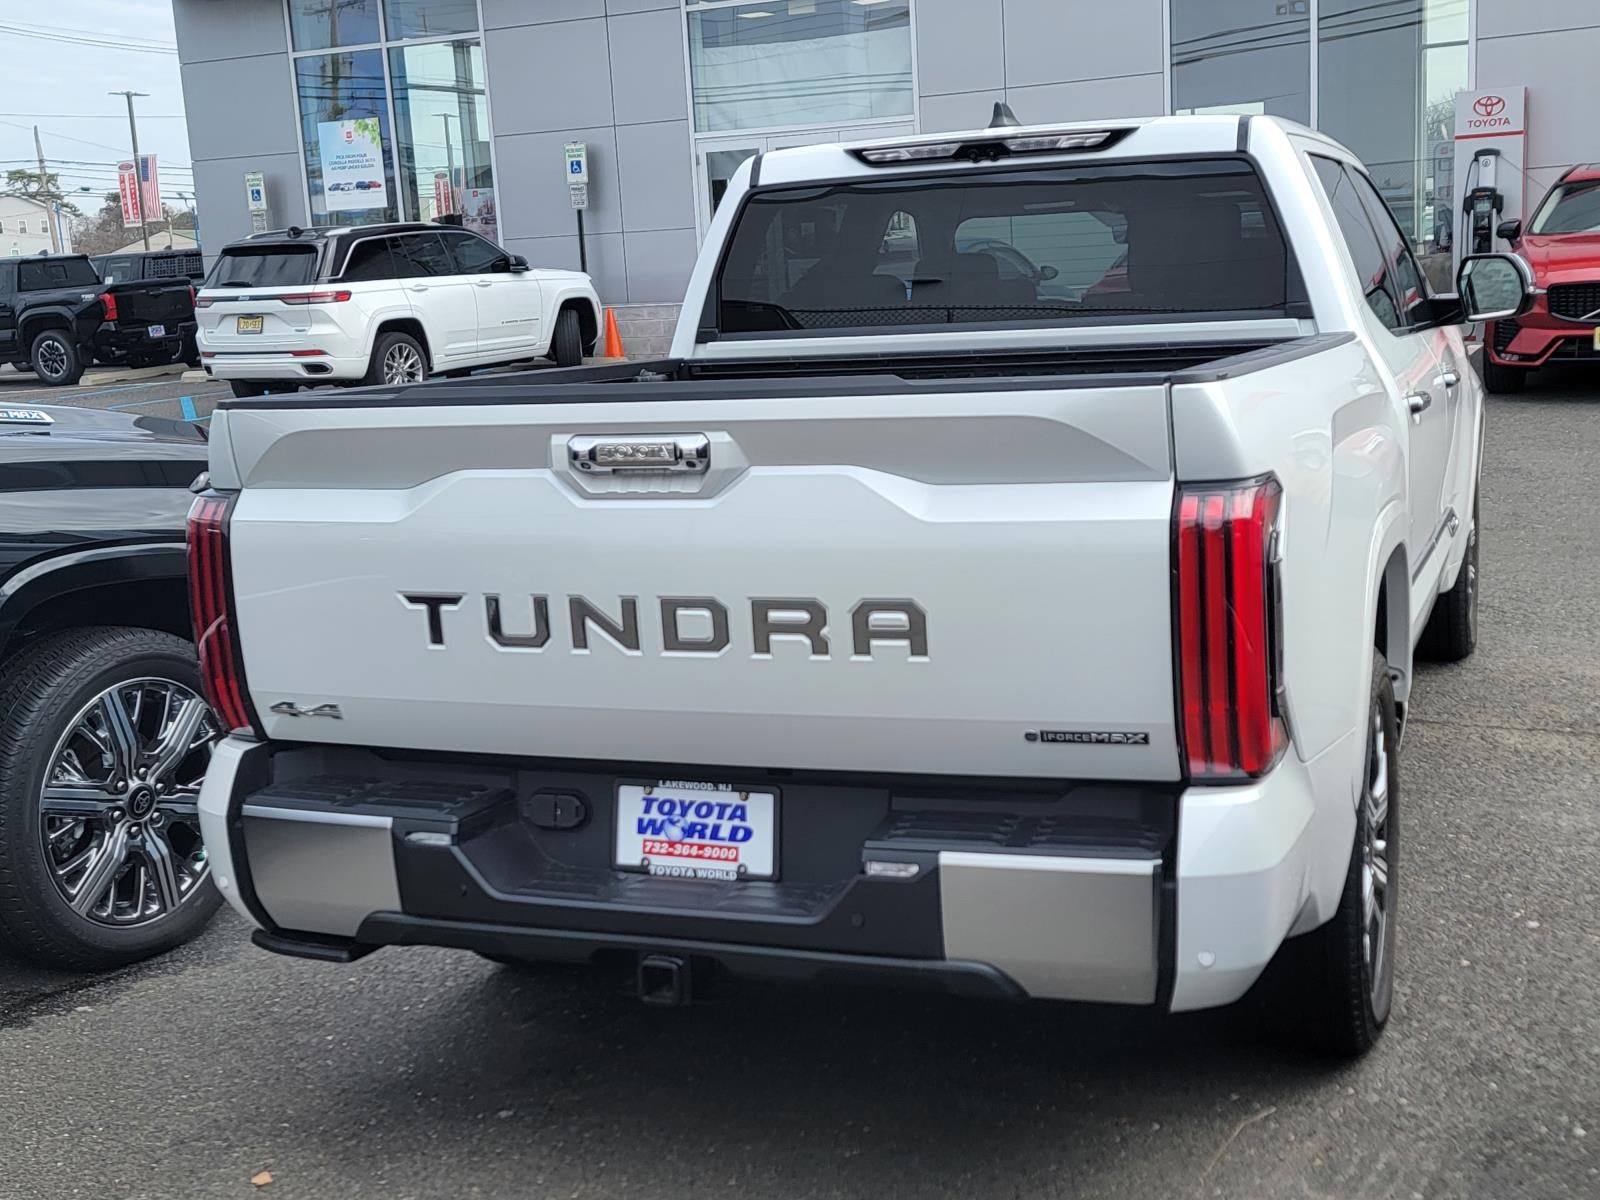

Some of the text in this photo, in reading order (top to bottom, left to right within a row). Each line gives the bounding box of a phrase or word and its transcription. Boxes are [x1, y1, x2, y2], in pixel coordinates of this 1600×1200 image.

[1467, 117, 1511, 129] TOYOTA
[604, 444, 671, 459] TOYOTA
[397, 591, 931, 663] TUNDRA
[718, 783, 733, 792] NJ
[641, 796, 748, 822] TOYOTA
[636, 816, 754, 843] WORLD
[643, 842, 737, 860] 732-364-9000
[648, 864, 738, 881] TOYOTA WORLD
